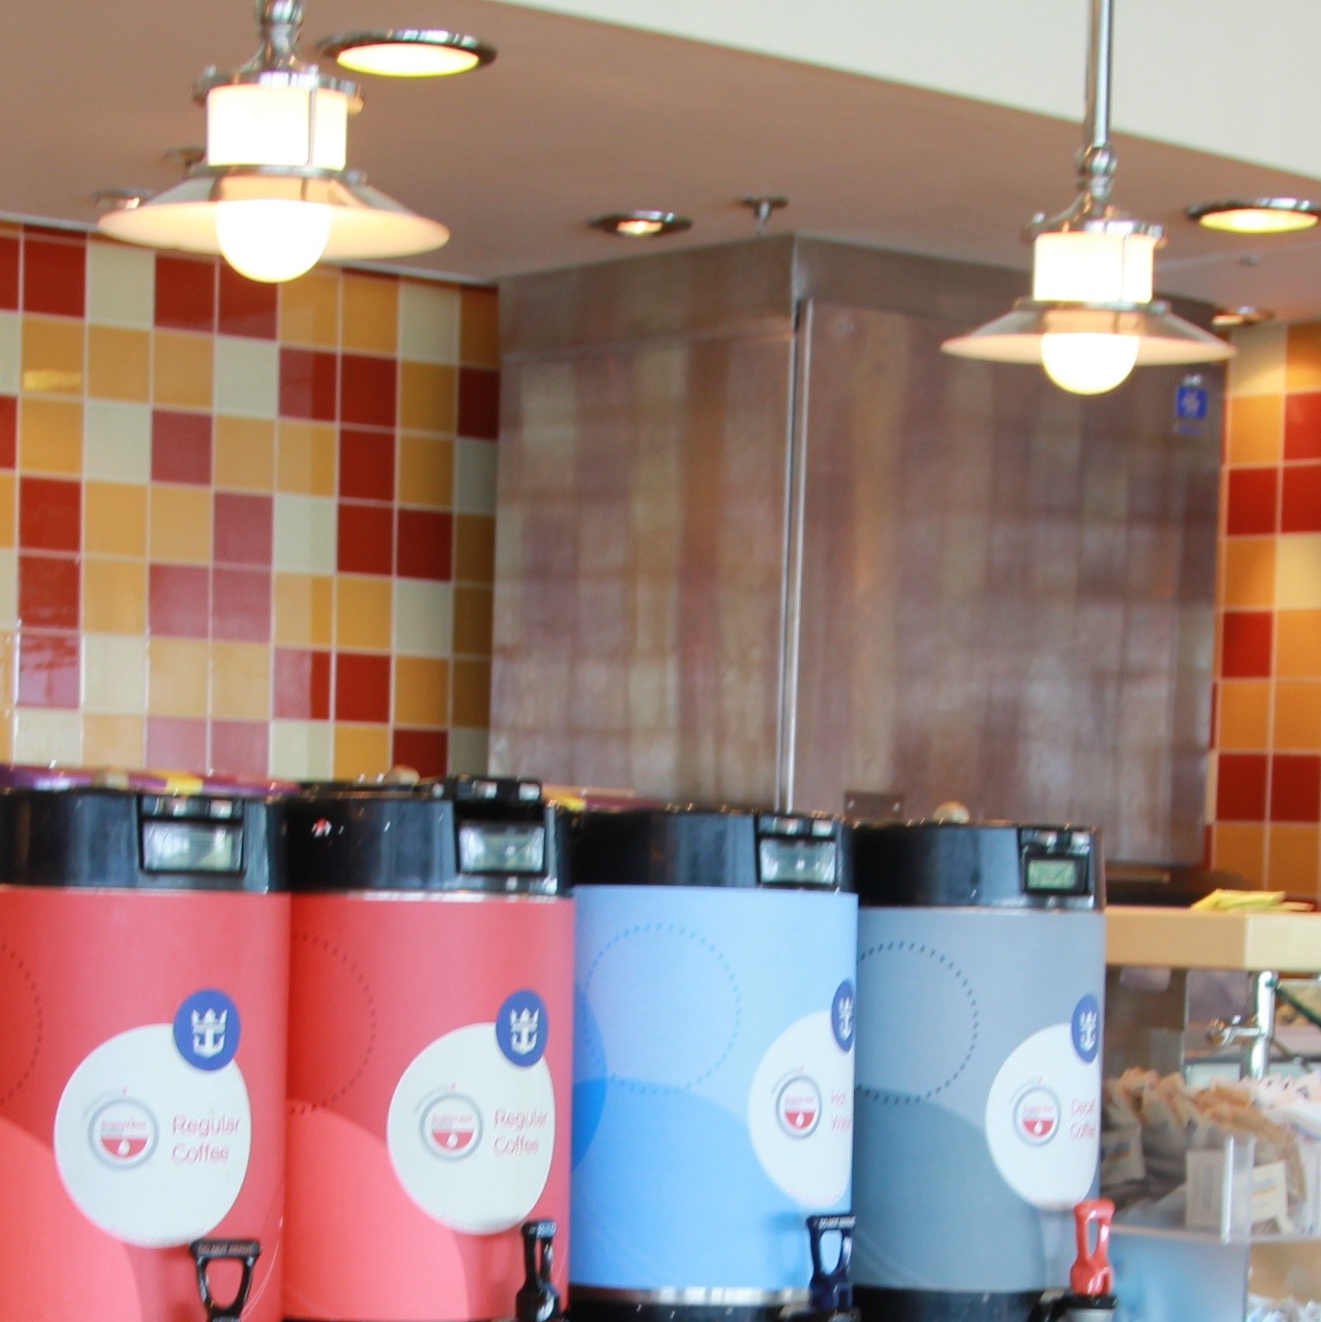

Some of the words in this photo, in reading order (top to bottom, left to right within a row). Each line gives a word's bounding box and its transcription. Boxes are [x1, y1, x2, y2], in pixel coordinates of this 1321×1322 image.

[173, 1114, 241, 1137] Regular
[495, 1108, 549, 1131] Regular
[172, 1142, 231, 1165] Coffee
[494, 1135, 540, 1157] Coffee
